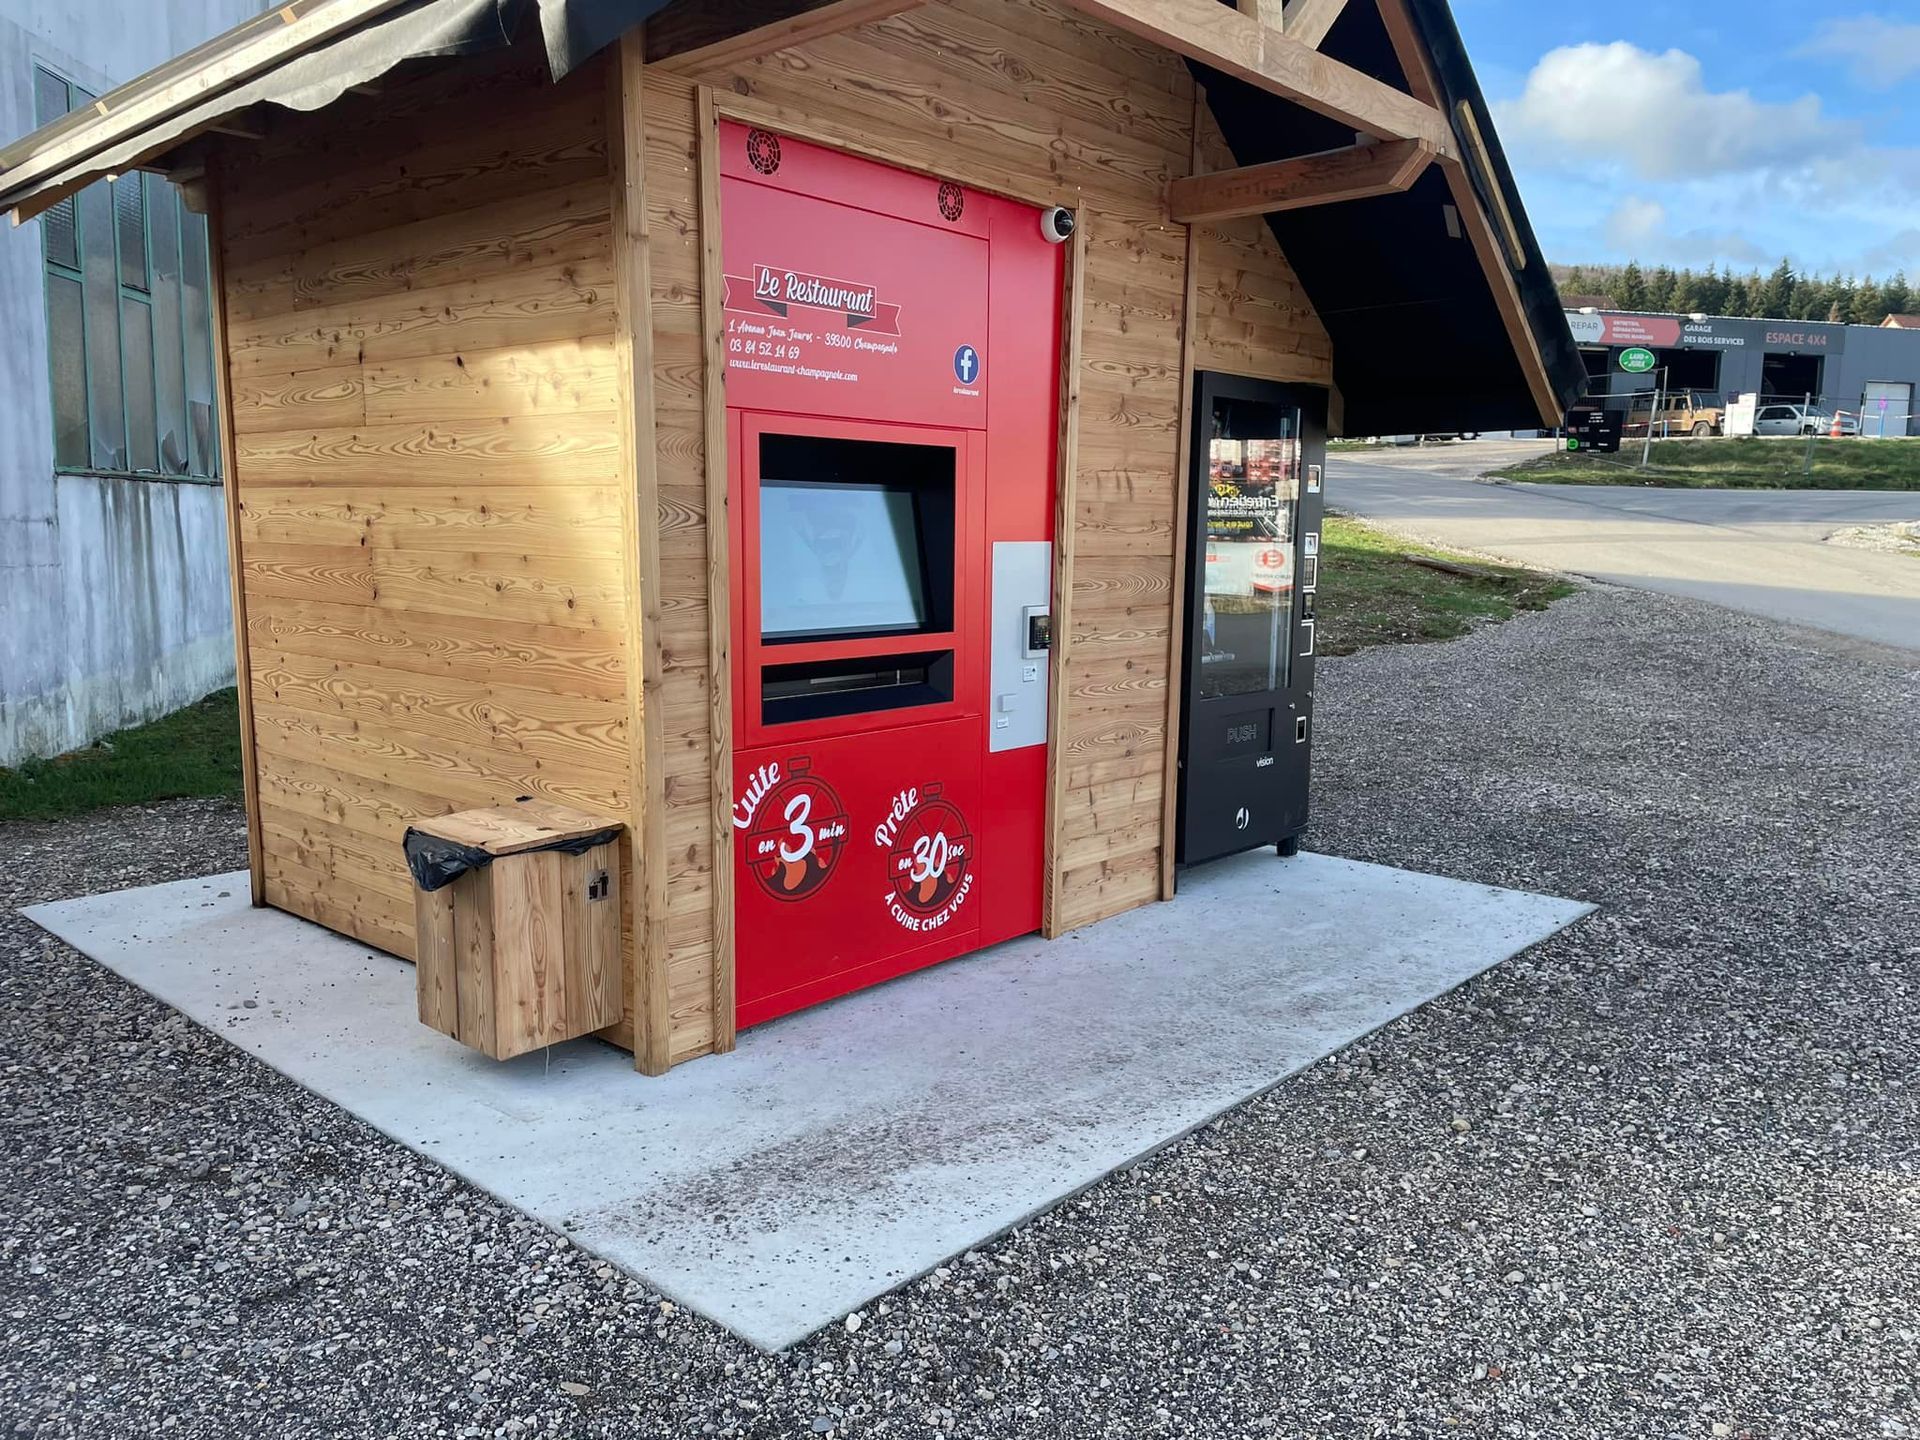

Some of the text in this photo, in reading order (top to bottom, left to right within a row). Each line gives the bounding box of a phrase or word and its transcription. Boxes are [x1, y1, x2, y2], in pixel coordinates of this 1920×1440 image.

[757, 268, 873, 313] Le Restaurant
[728, 318, 736, 332] 1
[824, 332, 852, 349] 39300
[1683, 335, 1745, 346] DES BOIS SERVICES
[1684, 324, 1713, 333] GARAGE
[1766, 331, 1827, 346] ESPACE 4X4
[730, 338, 742, 352] 03
[759, 341, 773, 356] 52
[788, 346, 800, 360] 69
[1227, 723, 1257, 744] PUSH
[1256, 756, 1274, 768] vision
[733, 761, 781, 830] Cuite
[758, 793, 846, 863] en 3 min
[874, 787, 919, 849] Prête
[898, 857, 913, 871] en
[910, 831, 947, 883] 30
[884, 873, 974, 932] A CUIRE CHEZ VOUS
